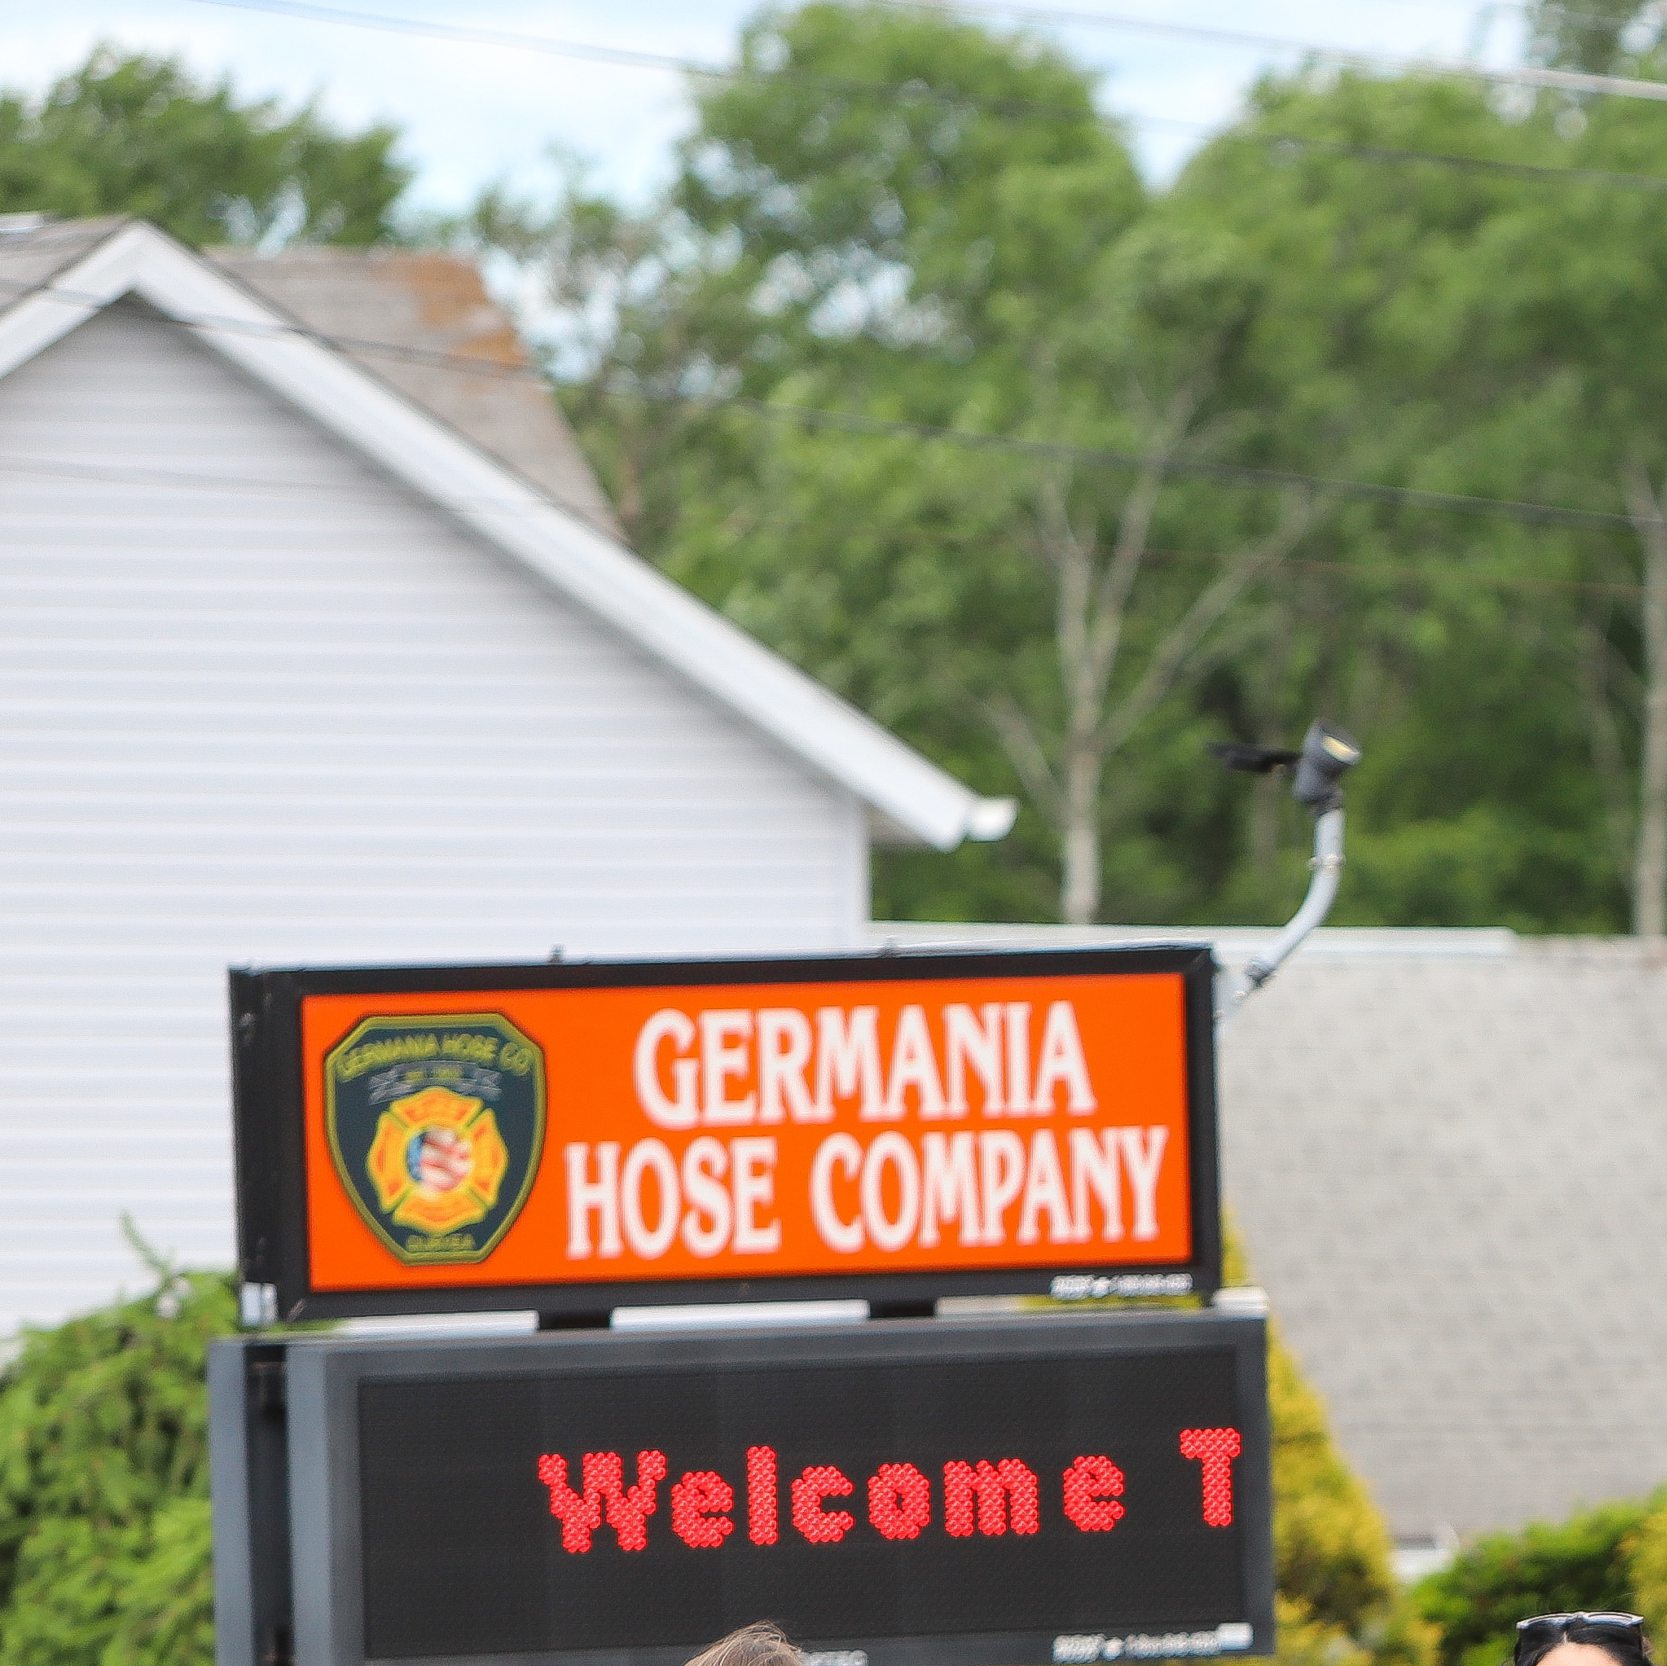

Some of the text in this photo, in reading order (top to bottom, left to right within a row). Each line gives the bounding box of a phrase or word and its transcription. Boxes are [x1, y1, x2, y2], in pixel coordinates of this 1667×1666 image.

[634, 1001, 1097, 1129] GERMANIA
[565, 1123, 1170, 1259] HOSE COMPANY
[537, 1426, 1242, 1554] Welcome T
